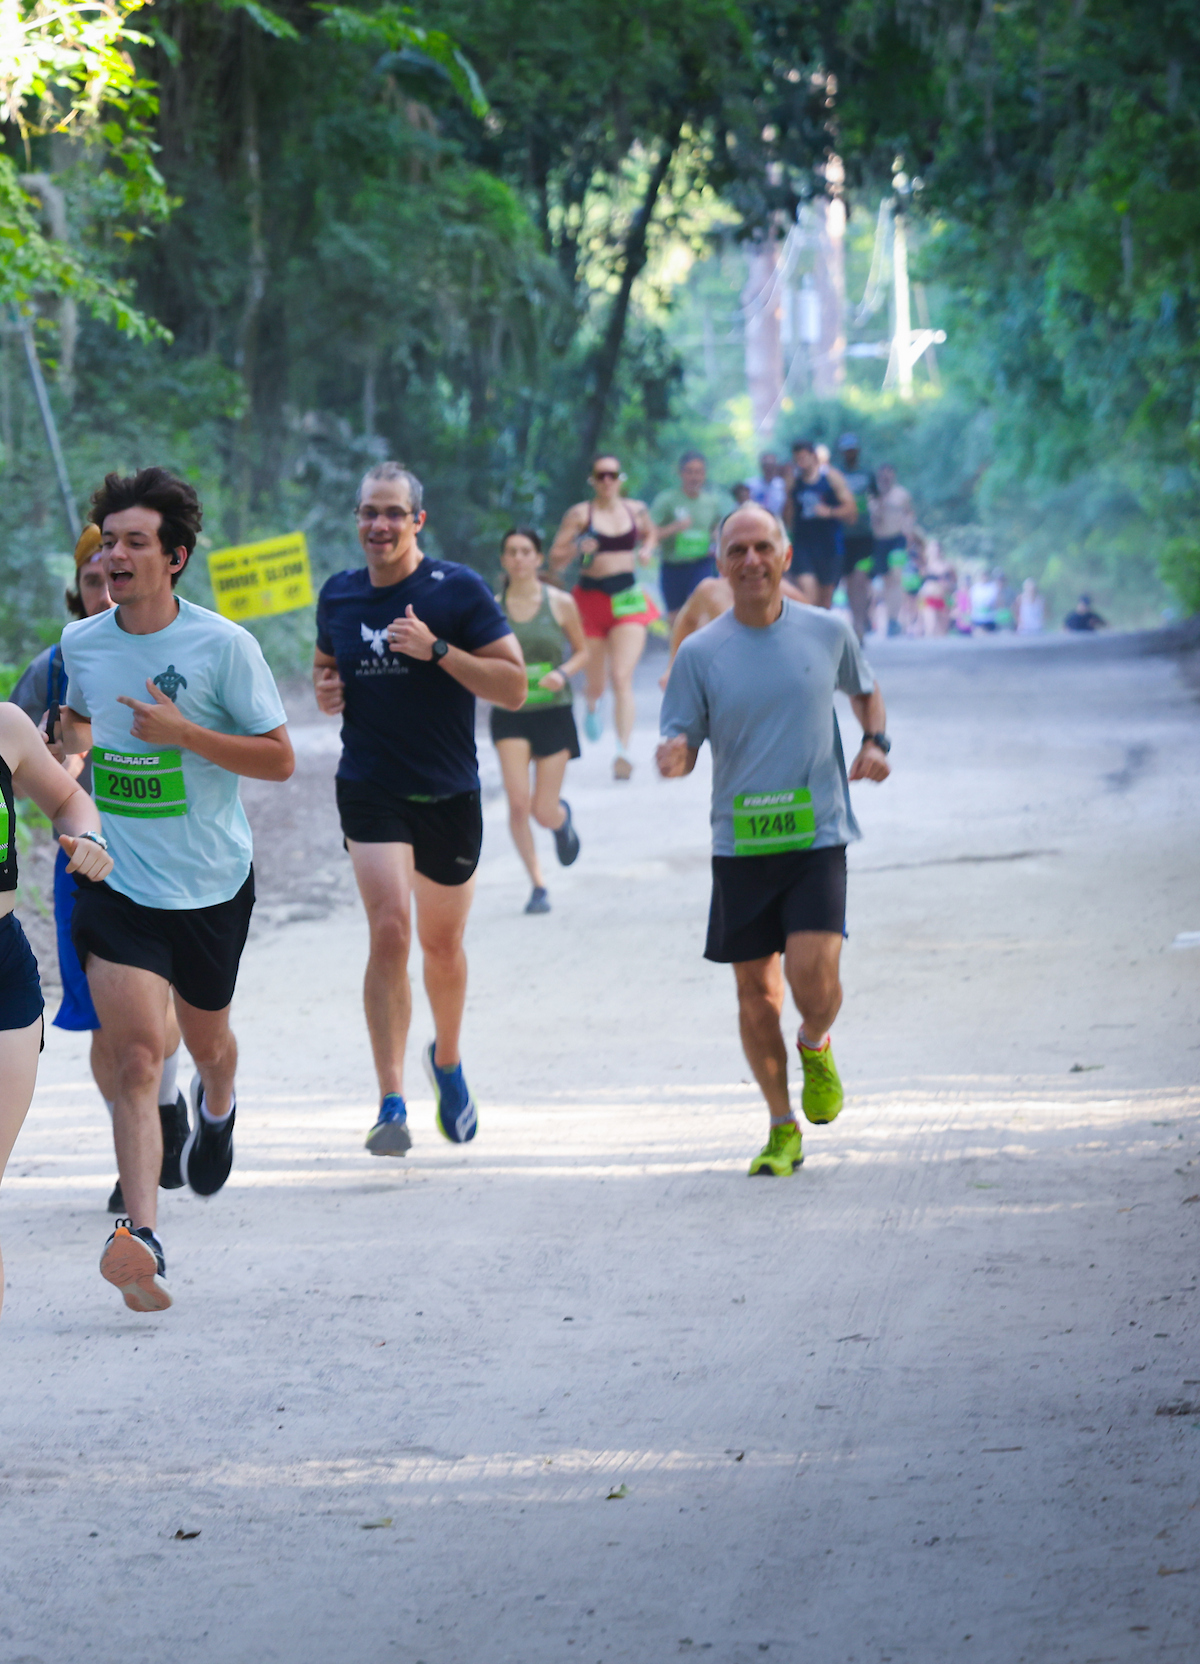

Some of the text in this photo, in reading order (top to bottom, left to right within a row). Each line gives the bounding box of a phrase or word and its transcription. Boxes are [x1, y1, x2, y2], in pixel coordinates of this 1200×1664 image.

[361, 658, 399, 667] MESA
[104, 752, 160, 765] ENDURANCE
[108, 773, 162, 799] 2909
[747, 811, 796, 836] 1248
